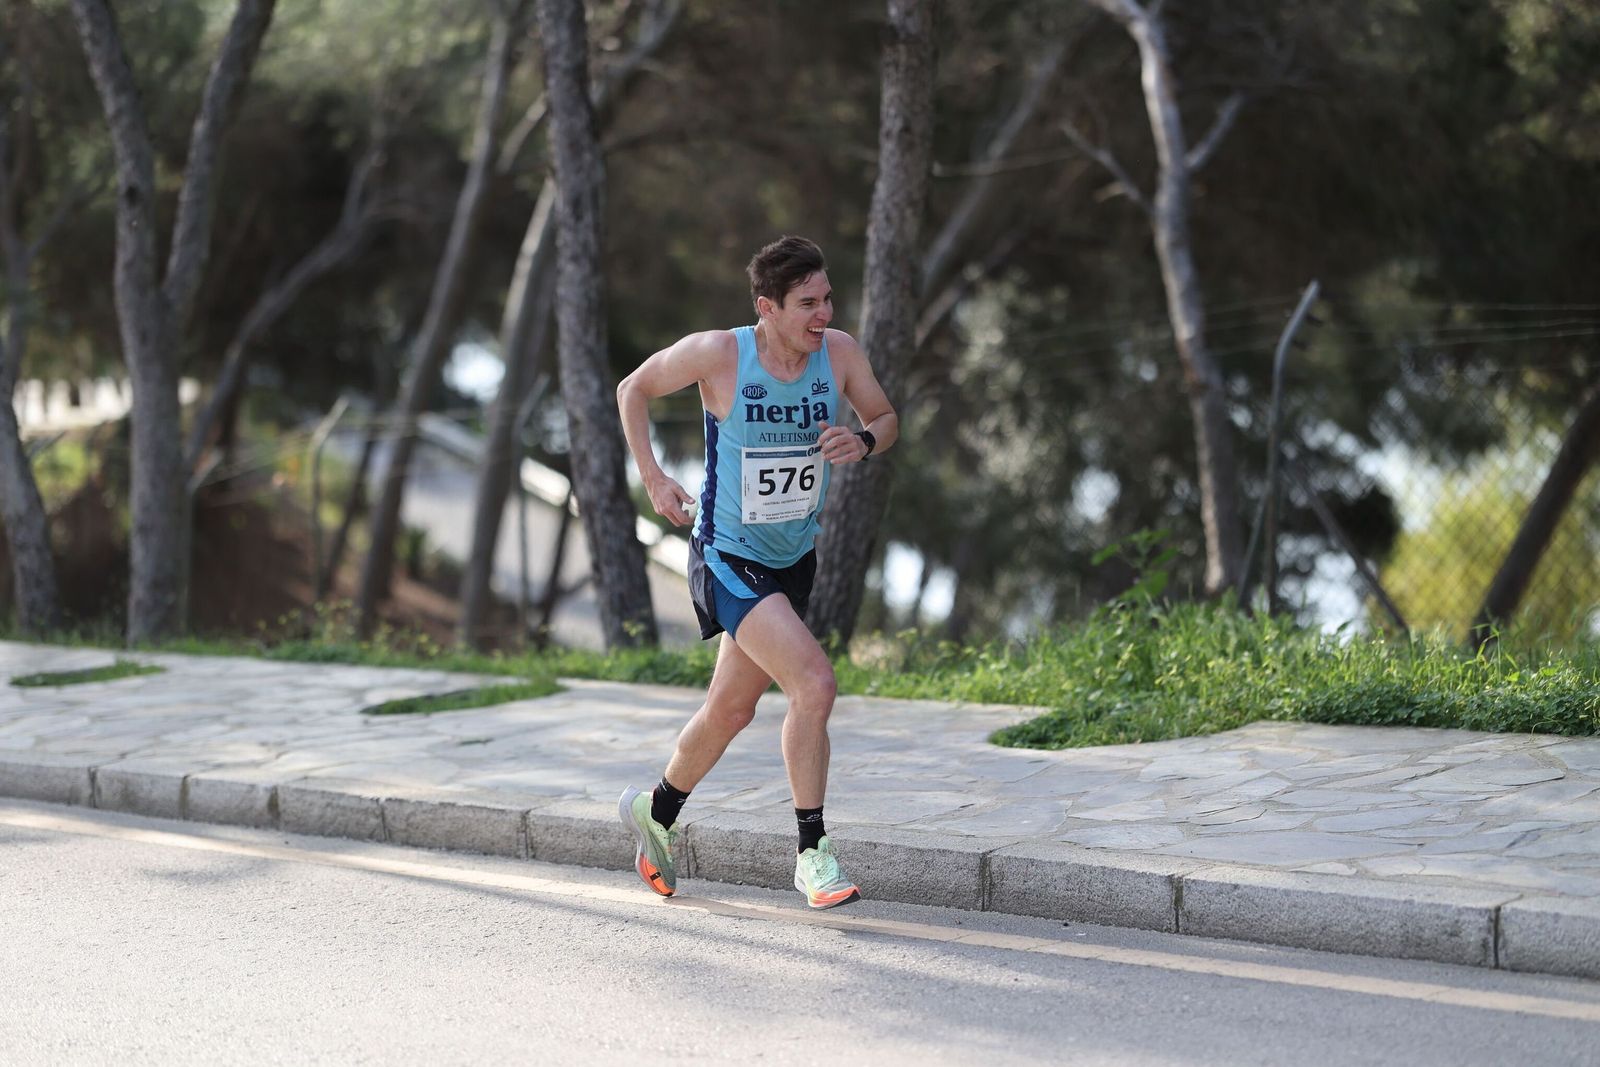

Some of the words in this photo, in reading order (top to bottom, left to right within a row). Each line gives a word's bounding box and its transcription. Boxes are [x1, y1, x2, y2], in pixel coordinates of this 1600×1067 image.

[743, 386, 767, 398] TROPS
[744, 396, 830, 430] nerja
[759, 431, 819, 443] ATLETISMO
[758, 464, 815, 496] 576
